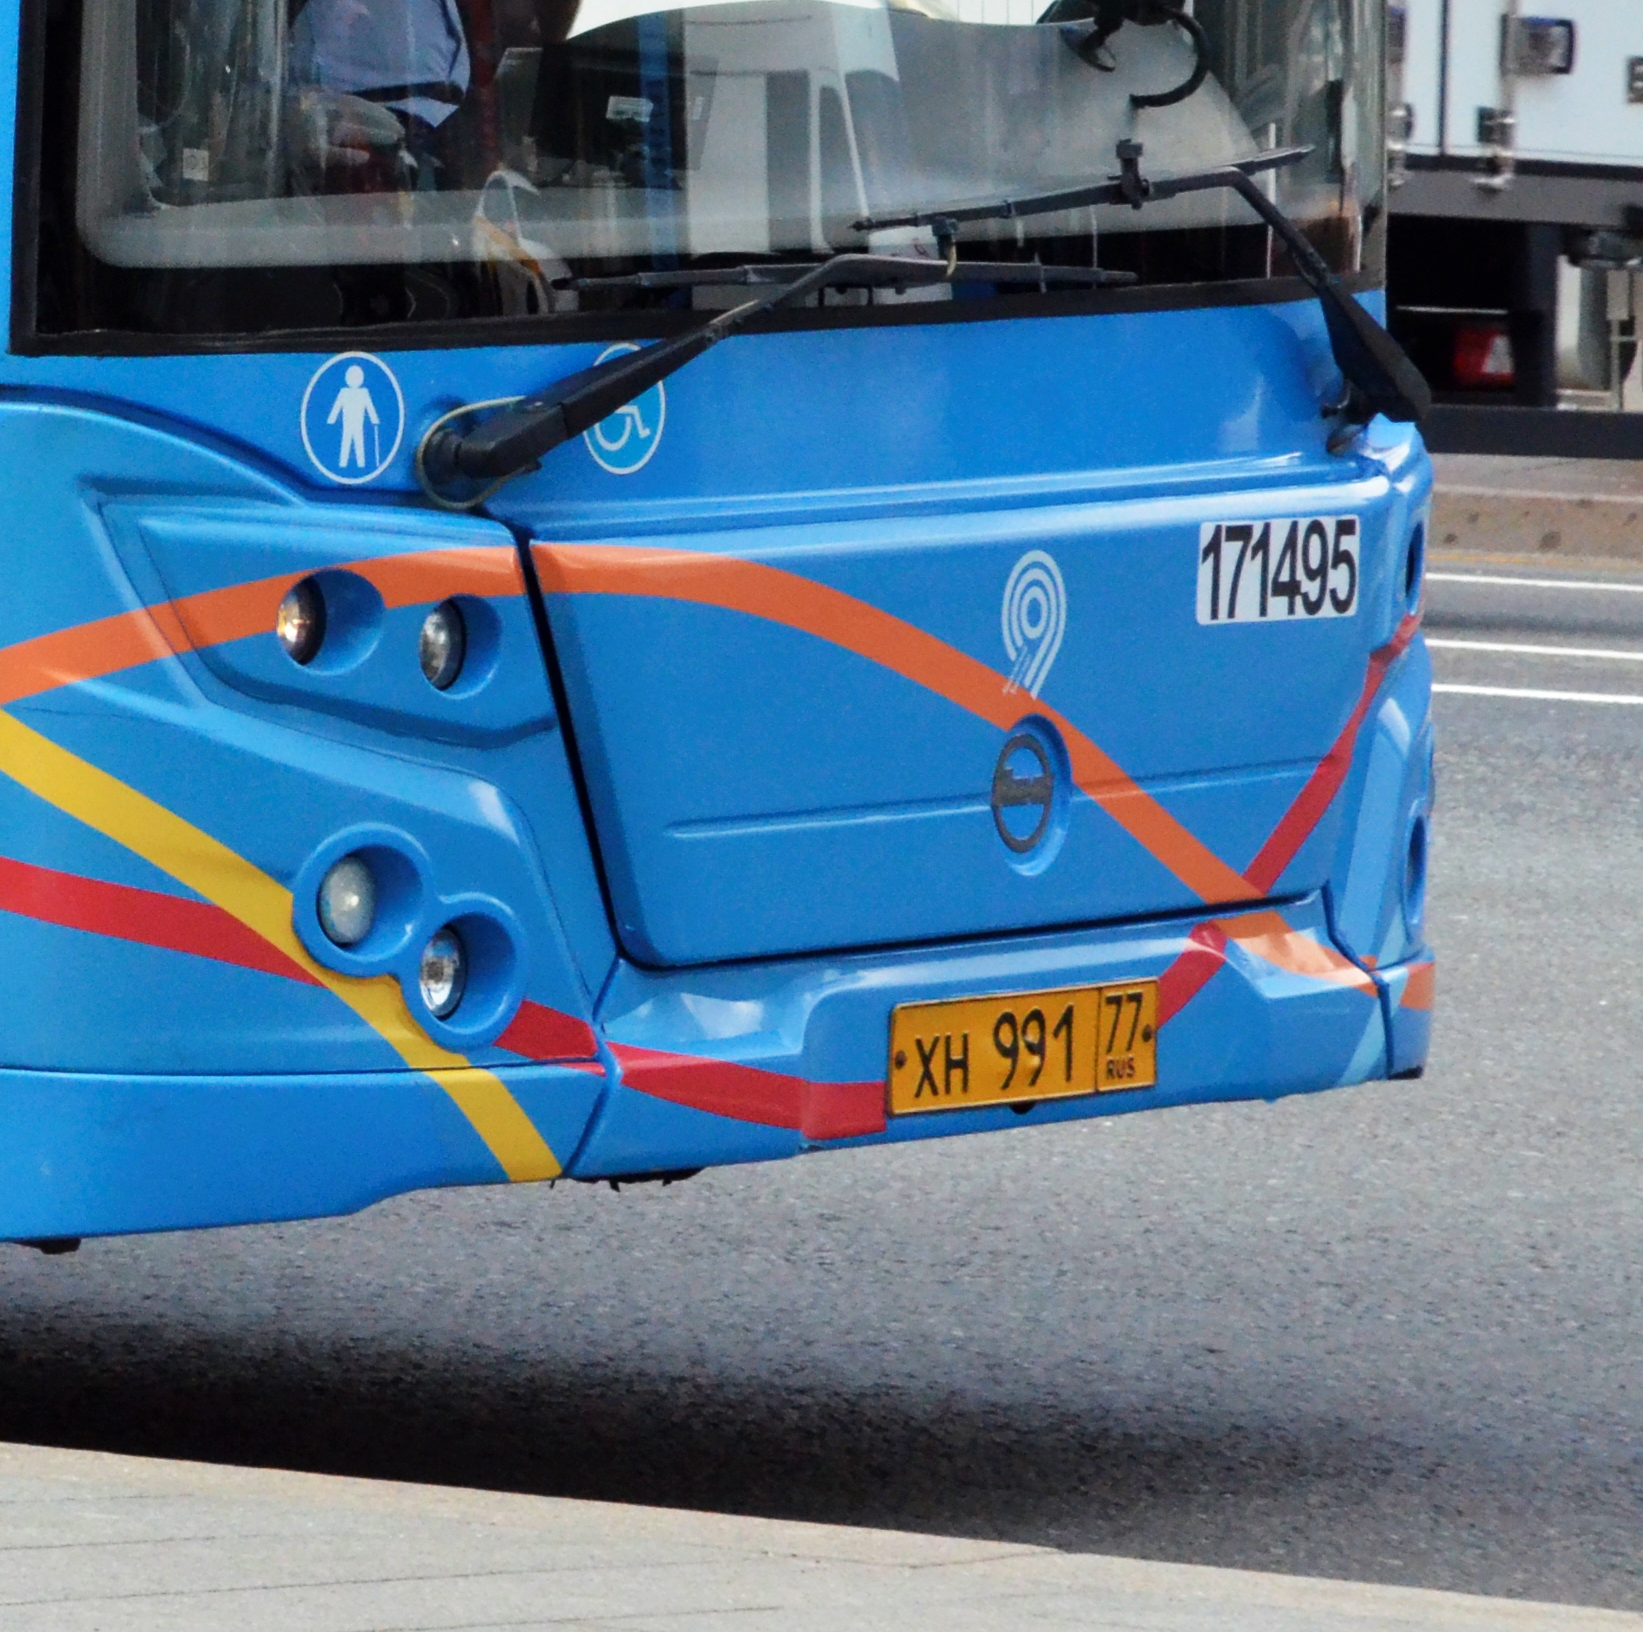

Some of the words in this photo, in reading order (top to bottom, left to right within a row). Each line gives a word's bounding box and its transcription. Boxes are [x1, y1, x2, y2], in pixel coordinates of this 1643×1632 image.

[1201, 518, 1357, 621] 171495
[993, 1001, 1075, 1090] 991
[1105, 990, 1144, 1055] 77
[1105, 1055, 1136, 1080] RUS
